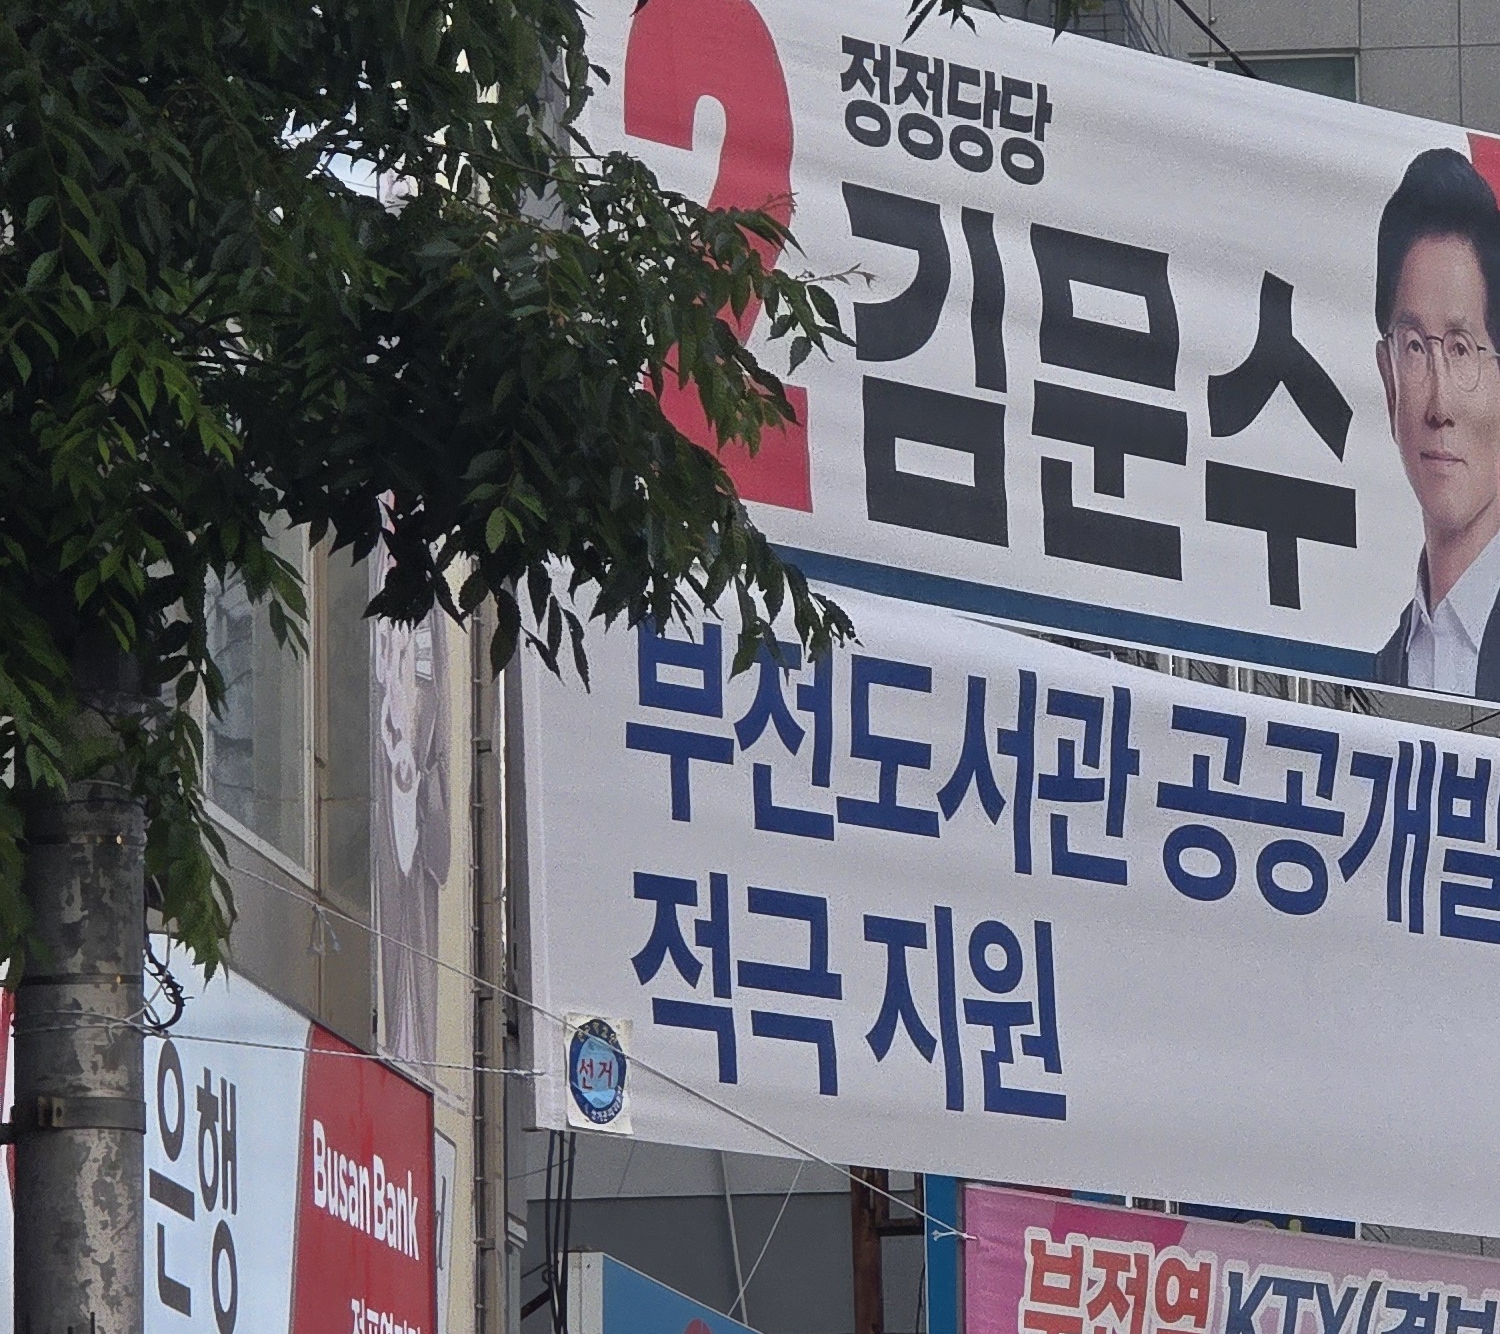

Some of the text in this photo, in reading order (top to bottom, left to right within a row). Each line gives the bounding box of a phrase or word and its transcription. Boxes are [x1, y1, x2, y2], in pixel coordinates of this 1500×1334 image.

[839, 34, 1053, 186] 정정당당
[841, 180, 1358, 611] 김문수
[625, 614, 1140, 886] 부전도서관
[630, 870, 1068, 1121] 적극 지원
[312, 1119, 420, 1262] Busan Bank
